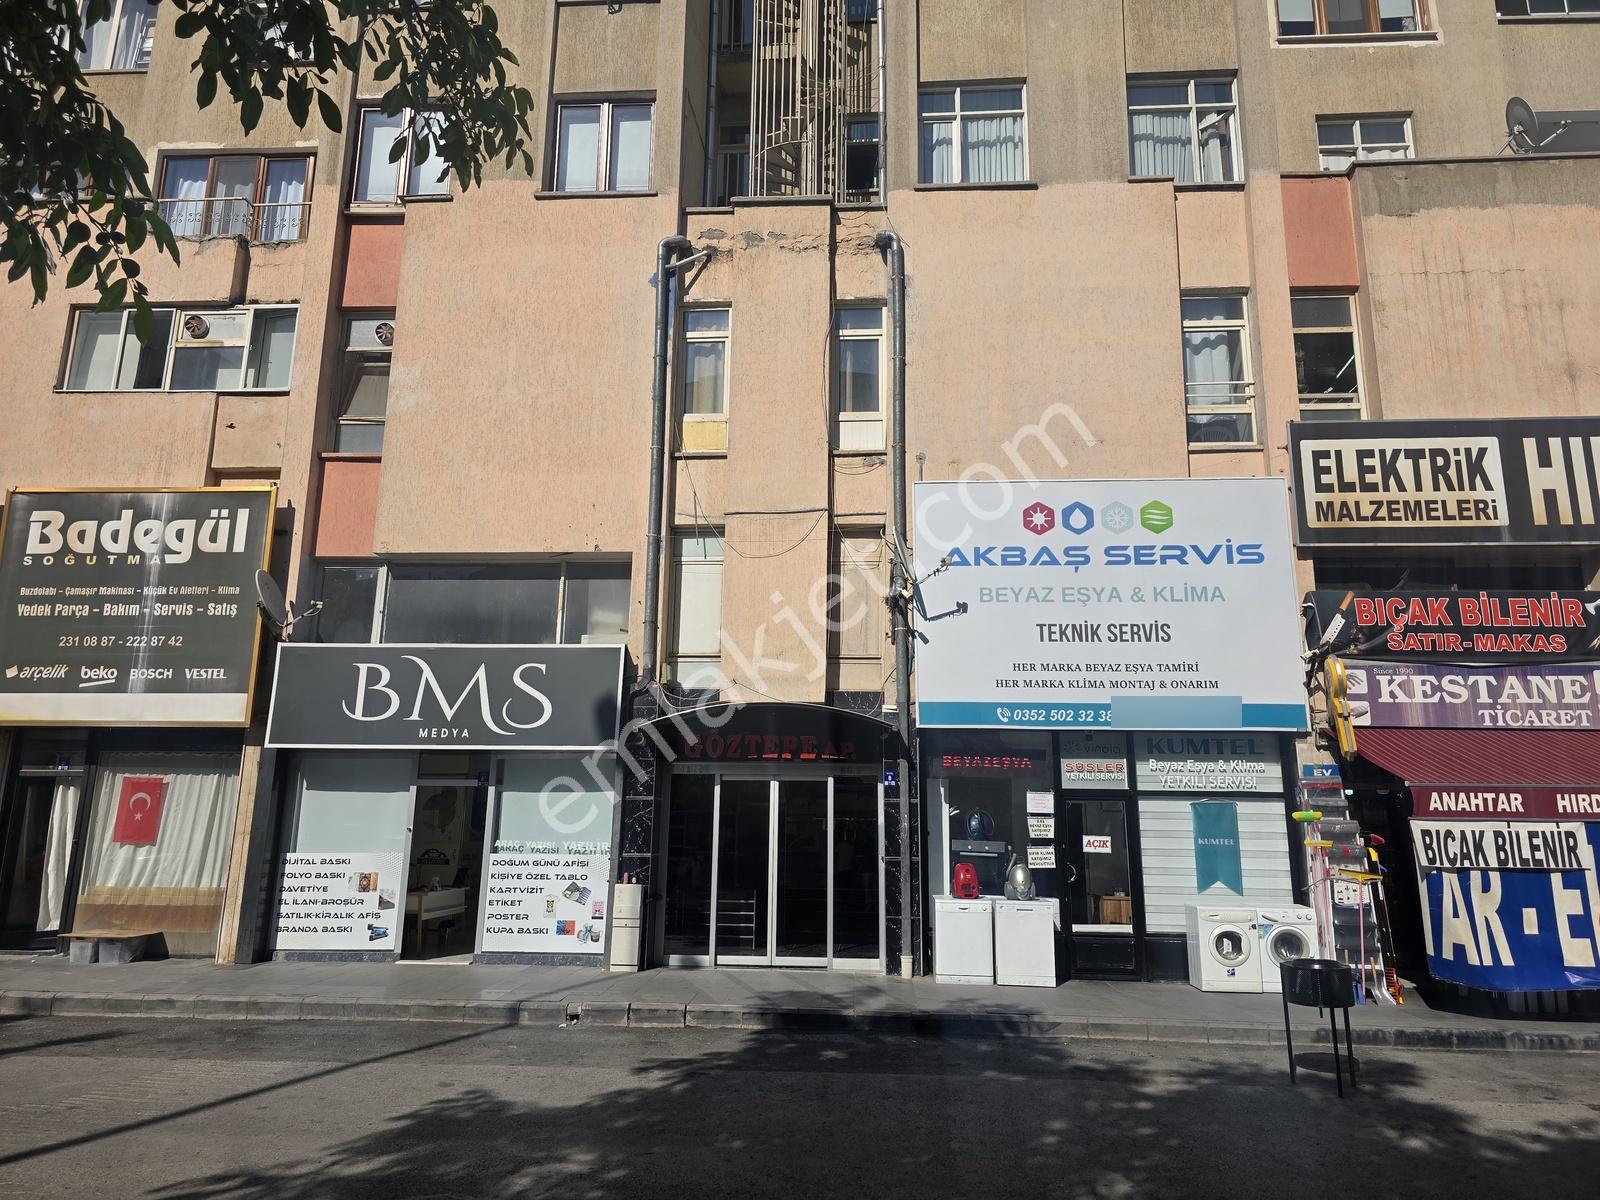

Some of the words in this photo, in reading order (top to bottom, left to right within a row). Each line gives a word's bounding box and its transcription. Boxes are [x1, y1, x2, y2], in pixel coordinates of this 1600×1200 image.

[26, 508, 250, 564] Badegül
[23, 554, 161, 565] SOĞUTMA
[945, 545, 1091, 573] AKBAŞ
[1103, 538, 1265, 567] SERVİS
[20, 586, 57, 596] Buzdolabı
[65, 586, 98, 597] Çamaşır
[99, 586, 135, 596] Makinası
[143, 586, 167, 596] Küçük
[169, 586, 178, 595] Ev
[180, 586, 209, 595] Aletleri
[218, 586, 240, 595] Klima
[979, 587, 1055, 603] BEYAZ
[1062, 587, 1123, 607] EŞYA
[1130, 587, 1145, 602] &
[1152, 582, 1226, 603] KLİMA
[17, 603, 51, 616] Yedek
[54, 603, 90, 618] Parça
[103, 603, 140, 616] Bakım
[153, 603, 194, 616] Servis
[207, 602, 238, 618] Satış
[1353, 597, 1453, 632] BIÇAK
[1458, 591, 1587, 628] BİLENİR
[1036, 620, 1102, 643] TEKNİK
[1107, 620, 1172, 643] SERVİS
[58, 636, 80, 647] 231
[83, 636, 97, 647] 08
[100, 636, 115, 647] 87
[126, 636, 147, 647] 222
[150, 636, 164, 647] 87
[168, 636, 183, 647] 42
[1387, 632, 1568, 653] SATIR-MAKAS
[19, 665, 70, 681] arçelik
[80, 665, 118, 679] beko
[130, 668, 173, 679] BOSCH
[185, 668, 227, 679] VESTEL
[1012, 662, 1037, 672] HER
[1040, 662, 1082, 672] MARKA
[1085, 662, 1122, 672] BEYAZ
[1124, 662, 1154, 675] EŞYA
[1156, 660, 1200, 672] TAMİRİ
[1373, 667, 1394, 675] Since
[1395, 667, 1414, 675] 1990
[995, 679, 1020, 688] HER
[1023, 679, 1066, 689] MARKA
[1068, 676, 1107, 689] KLİMA
[1108, 679, 1156, 690] MONTAJ
[1159, 679, 1168, 689] &
[1170, 679, 1220, 689] ONARIM
[1375, 675, 1592, 704] KESTANE
[342, 655, 553, 736] BMS
[1013, 709, 1046, 722] 0352
[1049, 709, 1074, 722] 502
[1078, 709, 1095, 722] 32
[1098, 710, 1112, 722] 38
[1478, 705, 1593, 727] TİCARET
[418, 727, 471, 738] MEDYA
[1146, 737, 1265, 755] KUMTEL
[1149, 758, 1184, 773] Beyaz
[1187, 759, 1215, 773] Eşya
[1218, 759, 1227, 770] &
[1230, 759, 1265, 771] Klima
[1429, 791, 1525, 813] ANAHTAR
[1085, 839, 1109, 850] AÇIK
[1198, 838, 1236, 846] KUMTEL
[1493, 822, 1583, 868] BİLENİR
[532, 859, 560, 867] GÜNÜ
[563, 859, 589, 869] AFİŞİ
[490, 871, 523, 881] KİŞİYE
[525, 872, 551, 880] ÖZEL
[279, 884, 329, 893] DAVETİYE
[489, 886, 545, 894] KARTVİZİT
[488, 898, 523, 906] ETİKET
[357, 911, 381, 920] AFİŞ
[487, 913, 529, 921] POSTER
